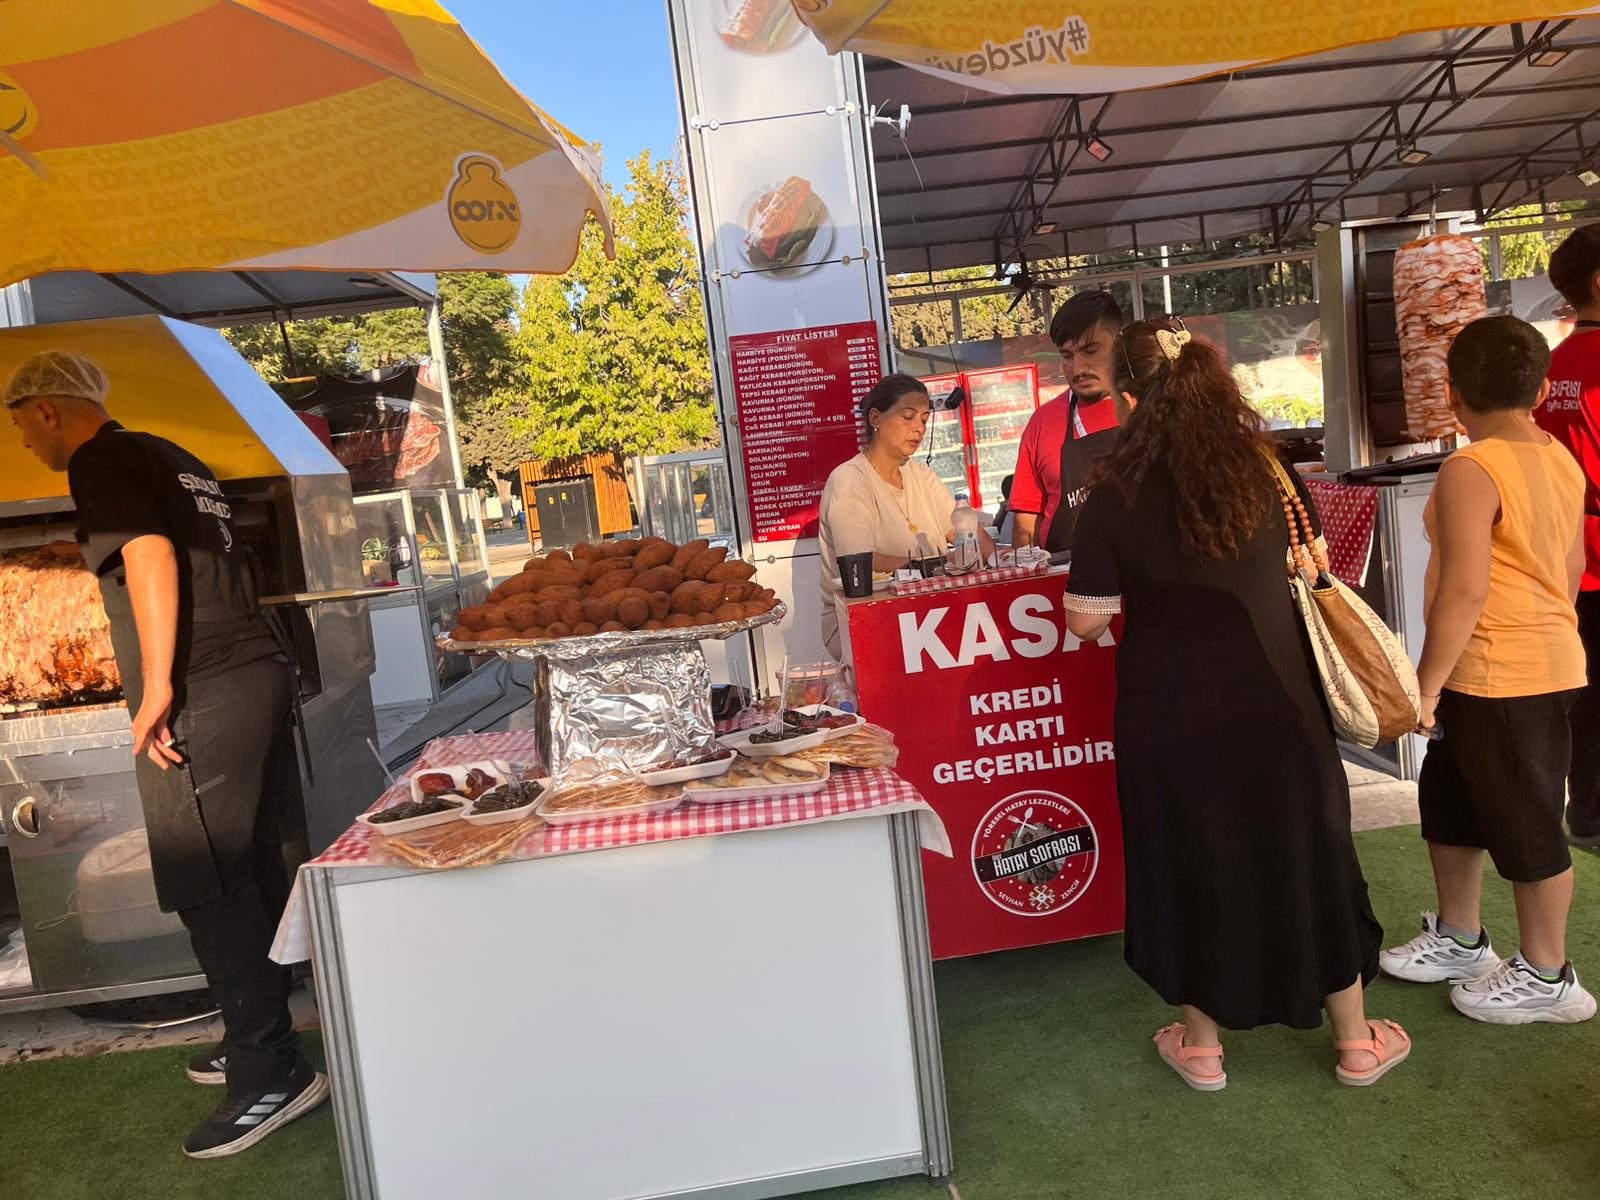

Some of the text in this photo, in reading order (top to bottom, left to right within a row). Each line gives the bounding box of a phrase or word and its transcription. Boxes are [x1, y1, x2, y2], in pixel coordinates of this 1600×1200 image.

[776, 328, 838, 343] FİYAT LİSTESİ
[740, 382, 772, 391] PATLICAN
[741, 390, 761, 398] TEPSİ
[761, 388, 786, 396] KEBABI
[742, 398, 775, 407] KAVURMA
[743, 406, 776, 415] KAVURMA
[759, 413, 784, 421] KEBABI
[760, 421, 785, 429] KEBABI
[745, 430, 783, 439] LAHMACUN
[780, 491, 804, 500] EKMEK
[757, 524, 800, 534] YAYIK AYRAN
[969, 678, 1062, 715] KREDİ
[975, 716, 1065, 746] KARTI
[933, 737, 1115, 784] GEÇERLİDİR
[1005, 799, 1028, 813] HATAY
[1028, 799, 1071, 816] LEZZETLERİ
[993, 835, 1081, 877] HATAY SOFRASI
[998, 891, 1024, 907] SEYHAN
